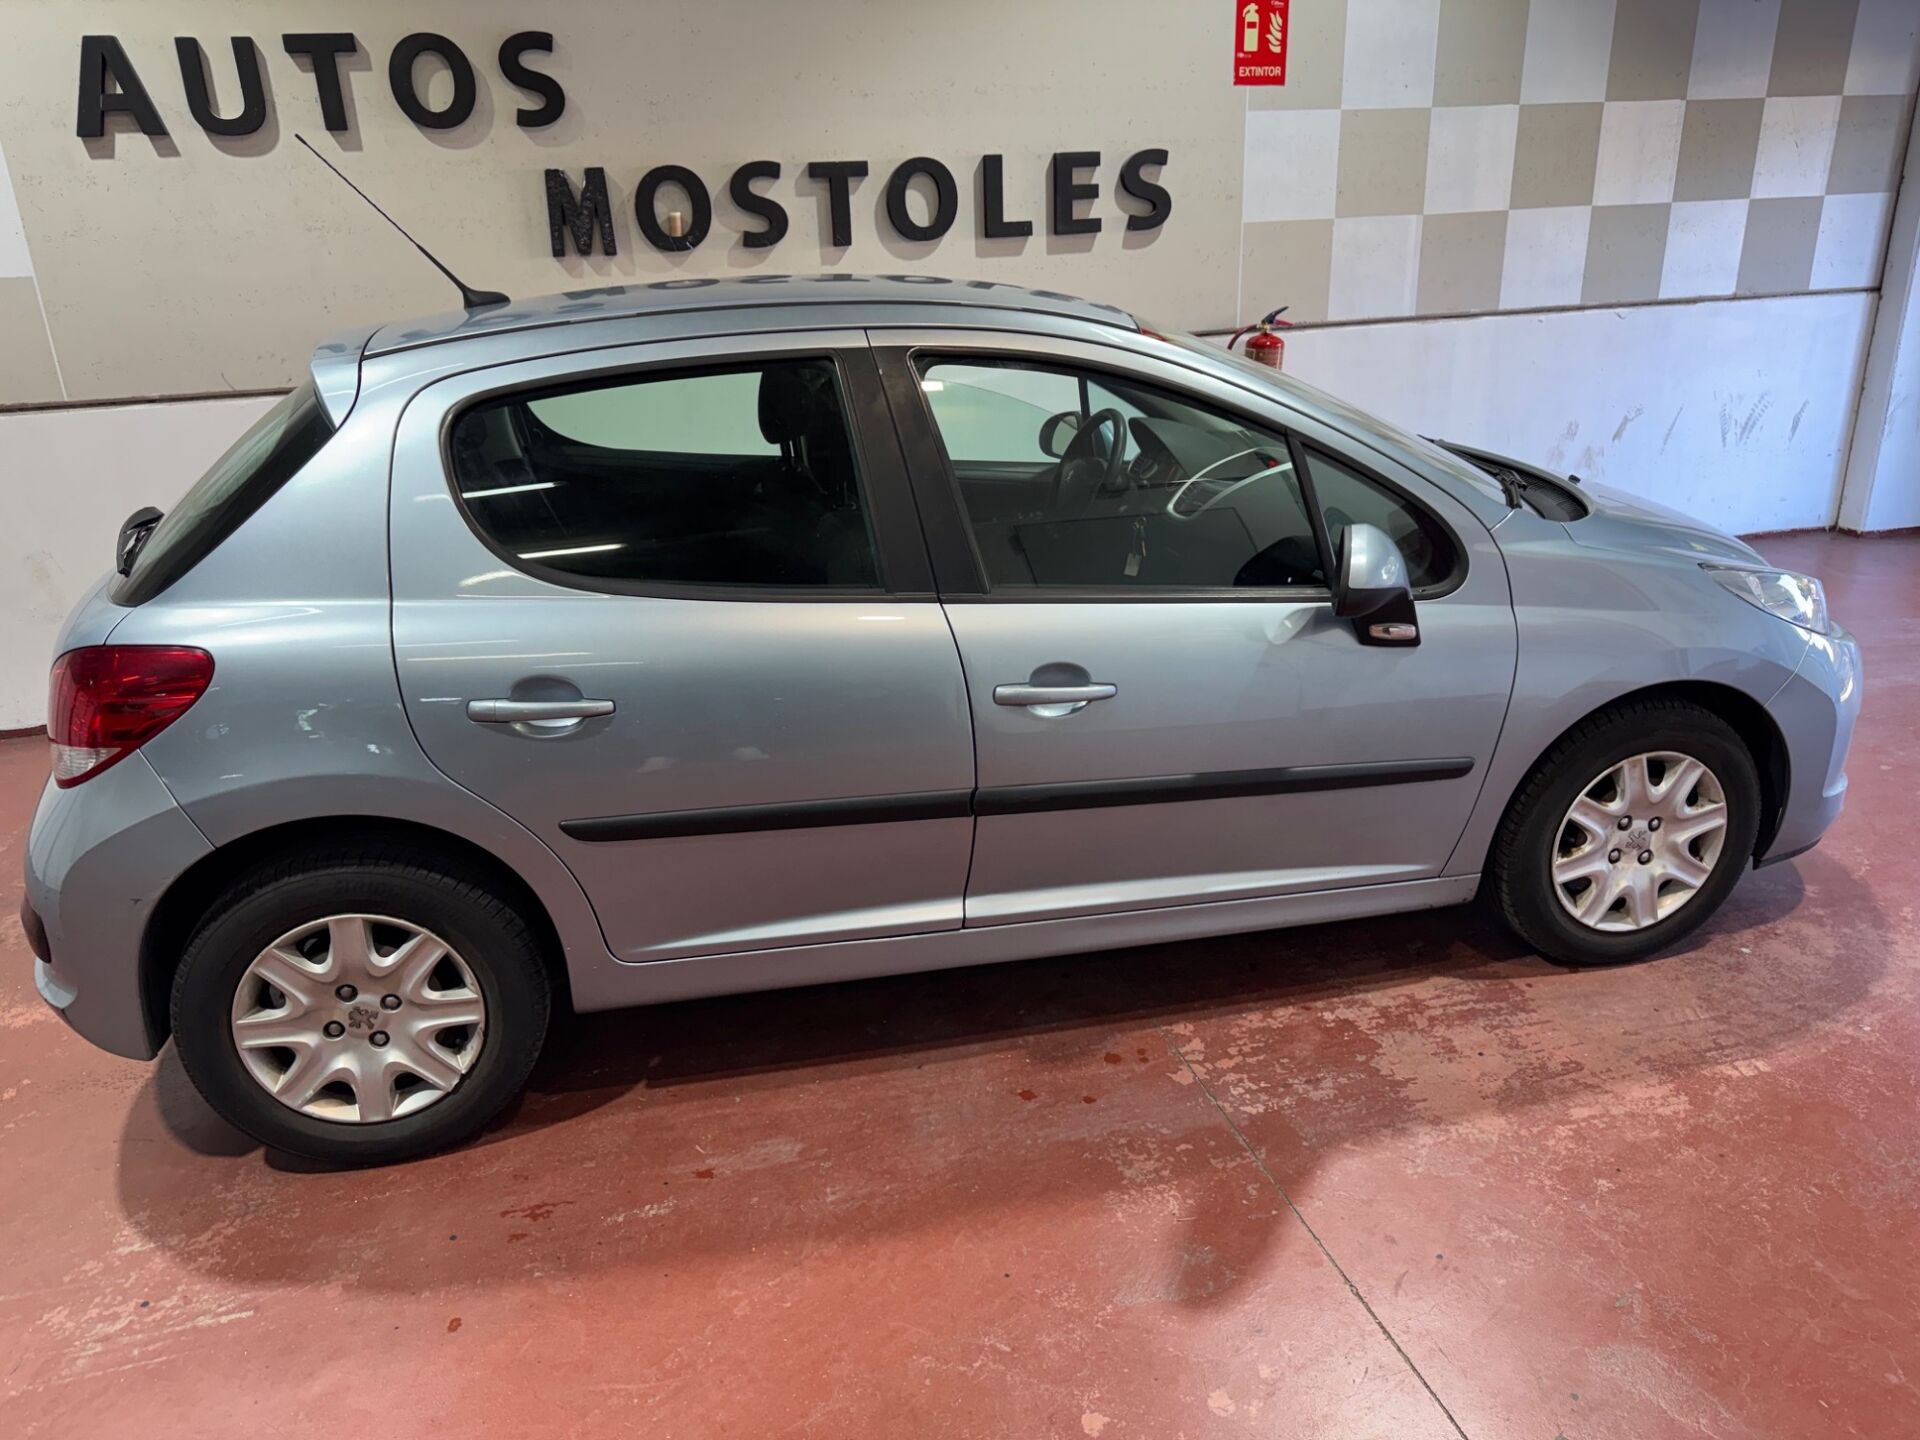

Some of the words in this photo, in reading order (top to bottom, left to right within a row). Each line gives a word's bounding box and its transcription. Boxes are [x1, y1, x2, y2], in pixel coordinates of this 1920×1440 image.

[77, 31, 565, 138] AUTOS
[1239, 66, 1281, 77] EXTINTOR
[544, 149, 1172, 258] MOSTOLES
